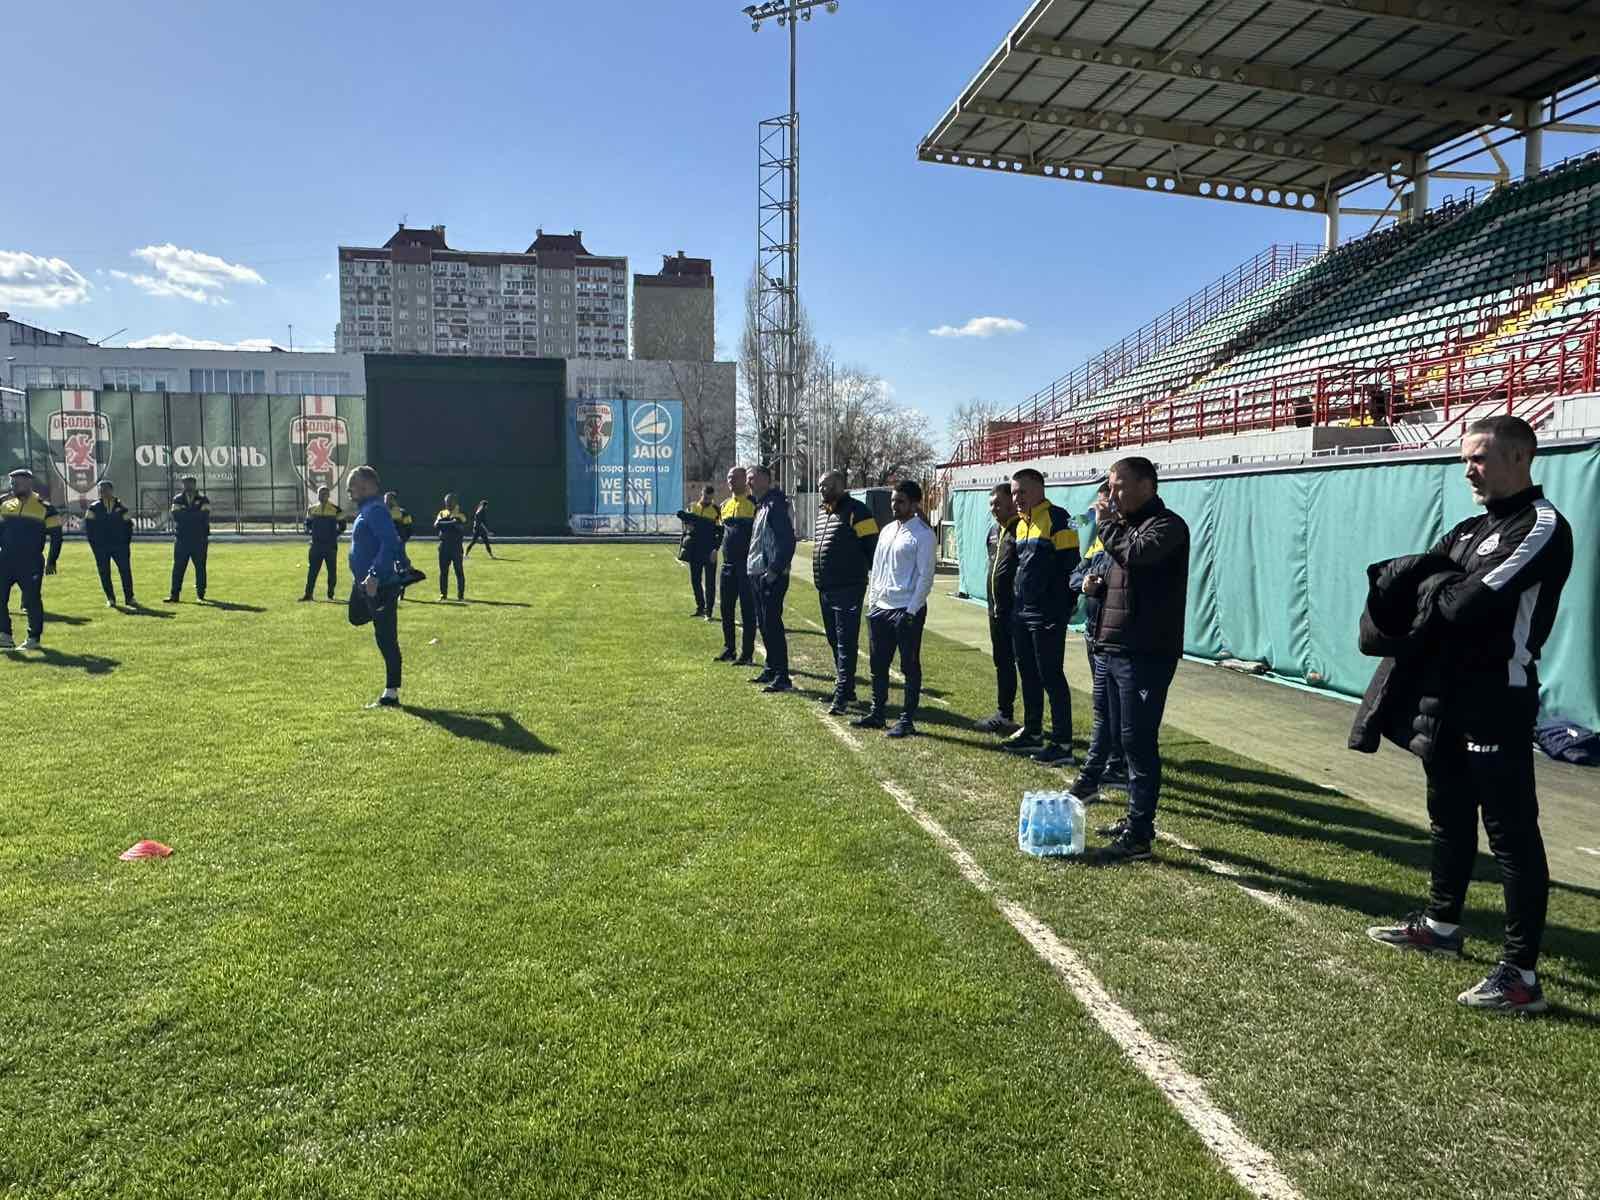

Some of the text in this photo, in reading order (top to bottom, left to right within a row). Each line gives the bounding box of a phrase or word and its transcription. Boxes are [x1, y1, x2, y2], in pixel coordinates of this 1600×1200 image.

[632, 445, 672, 458] JAKO
[585, 463, 671, 475] jakospot.comua
[600, 478, 652, 489] WE ARE
[600, 490, 652, 505] TEAM
